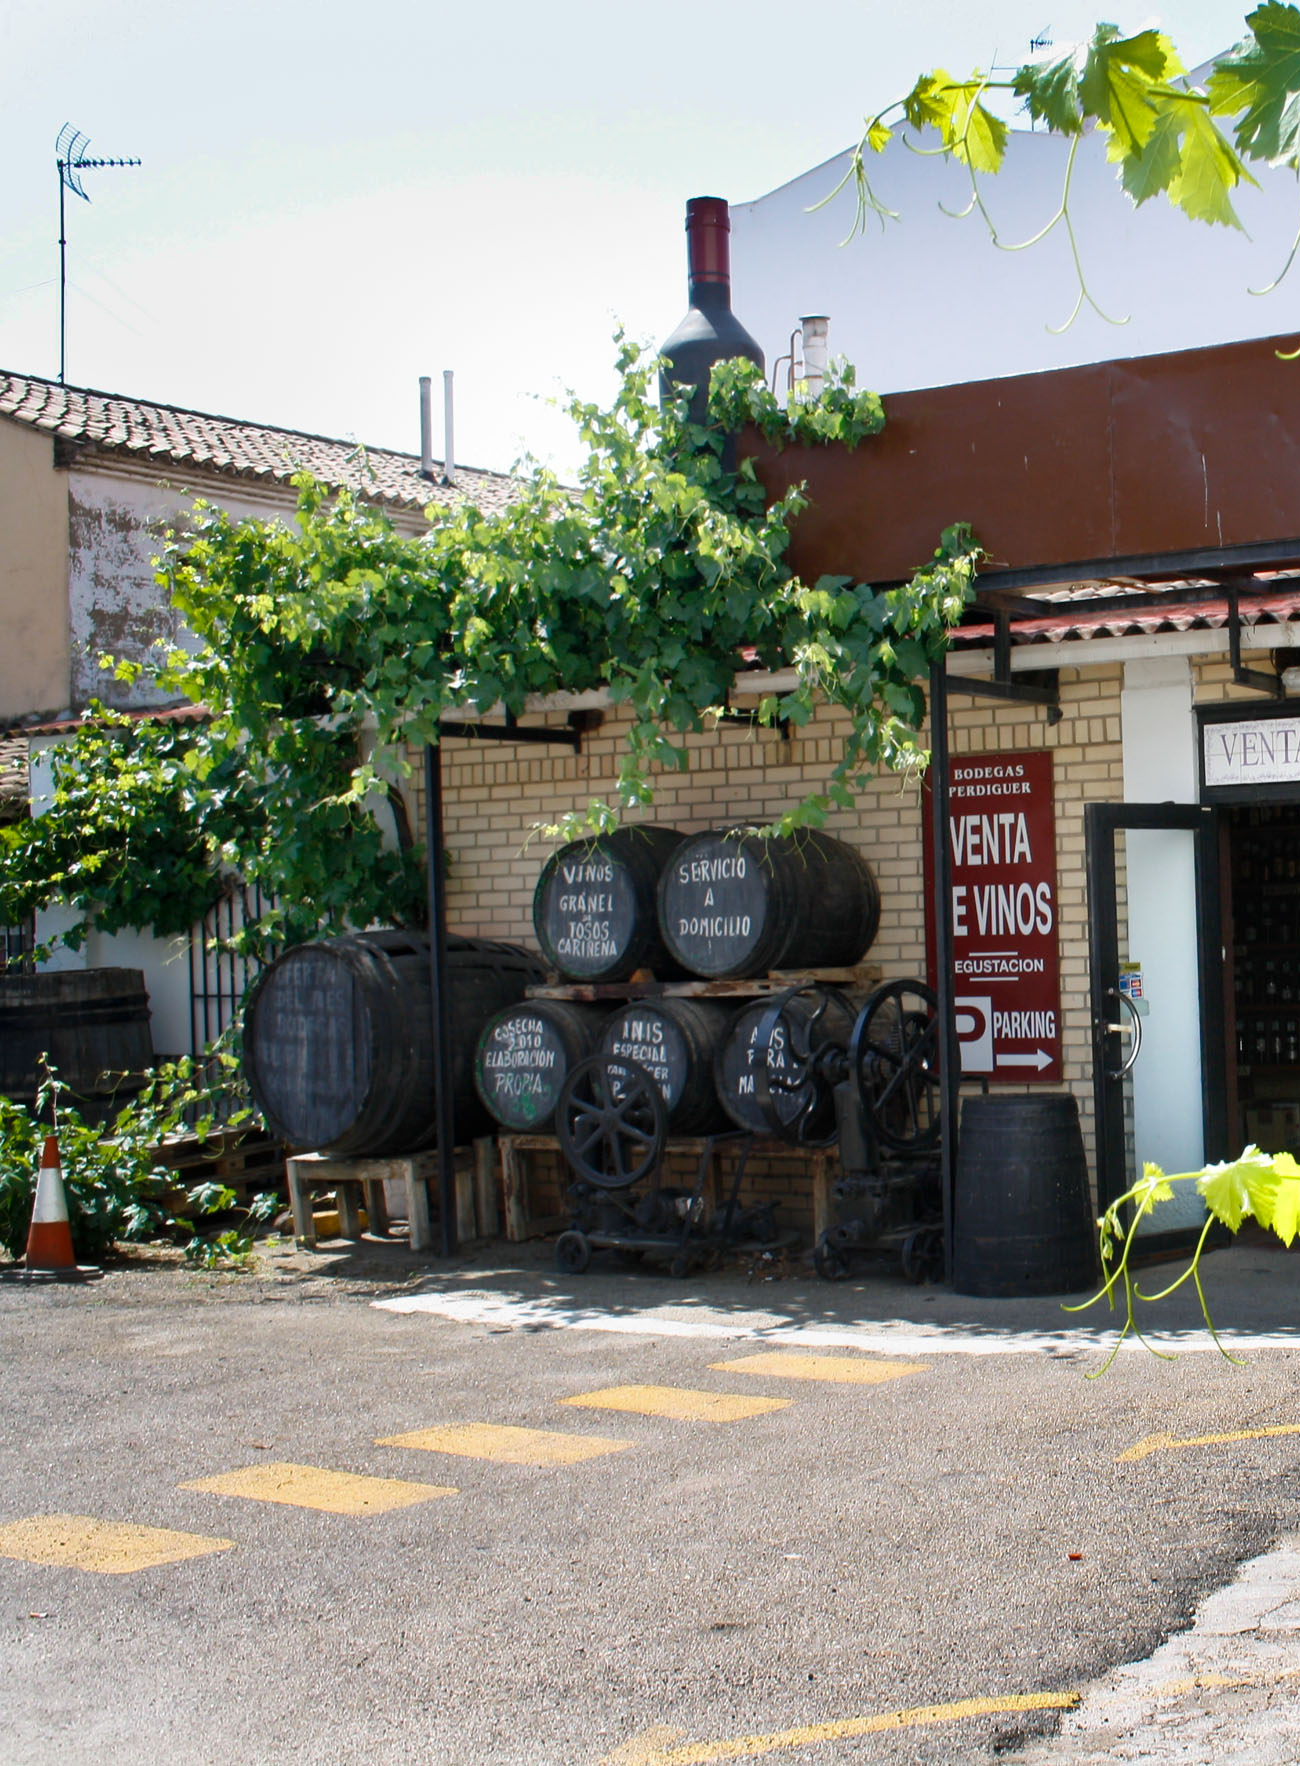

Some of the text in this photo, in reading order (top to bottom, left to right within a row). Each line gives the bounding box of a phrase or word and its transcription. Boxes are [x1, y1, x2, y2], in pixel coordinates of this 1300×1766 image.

[954, 765, 1024, 780] BODEGAS
[949, 782, 1031, 797] PERDIGUER
[950, 812, 1032, 866] VENTA
[562, 864, 614, 884] VINOS
[679, 857, 746, 884] SERVICIO
[704, 888, 714, 906] A
[973, 882, 1053, 936] VINOS
[569, 921, 609, 941] TOSOS
[679, 915, 750, 937] DOMICILIO
[954, 959, 1044, 973] EGUSTACION
[494, 1018, 543, 1040] COSECHA
[993, 1010, 1056, 1039] PARKING
[751, 1026, 784, 1049] AIS
[613, 1043, 666, 1062] ESPECIAL
[746, 1049, 785, 1068] PRA
